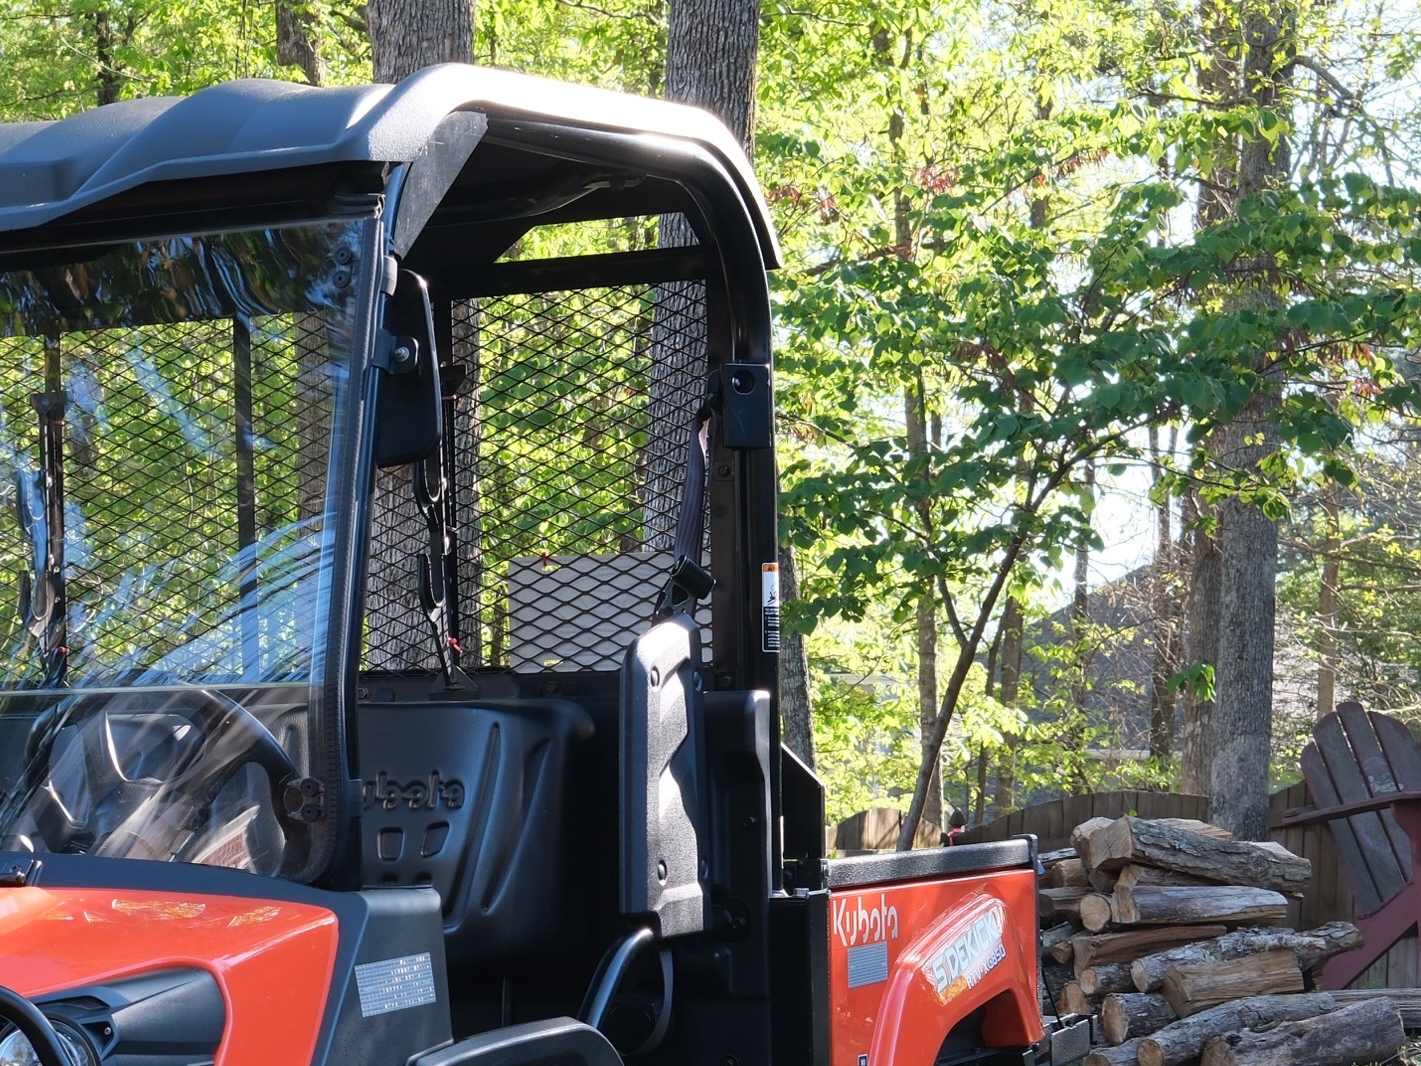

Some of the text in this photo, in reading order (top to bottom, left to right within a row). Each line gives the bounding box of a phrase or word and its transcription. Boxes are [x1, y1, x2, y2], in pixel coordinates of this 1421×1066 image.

[363, 769, 465, 811] ubota
[833, 893, 898, 947] Kubota
[932, 910, 1002, 993] SIDEKICK
